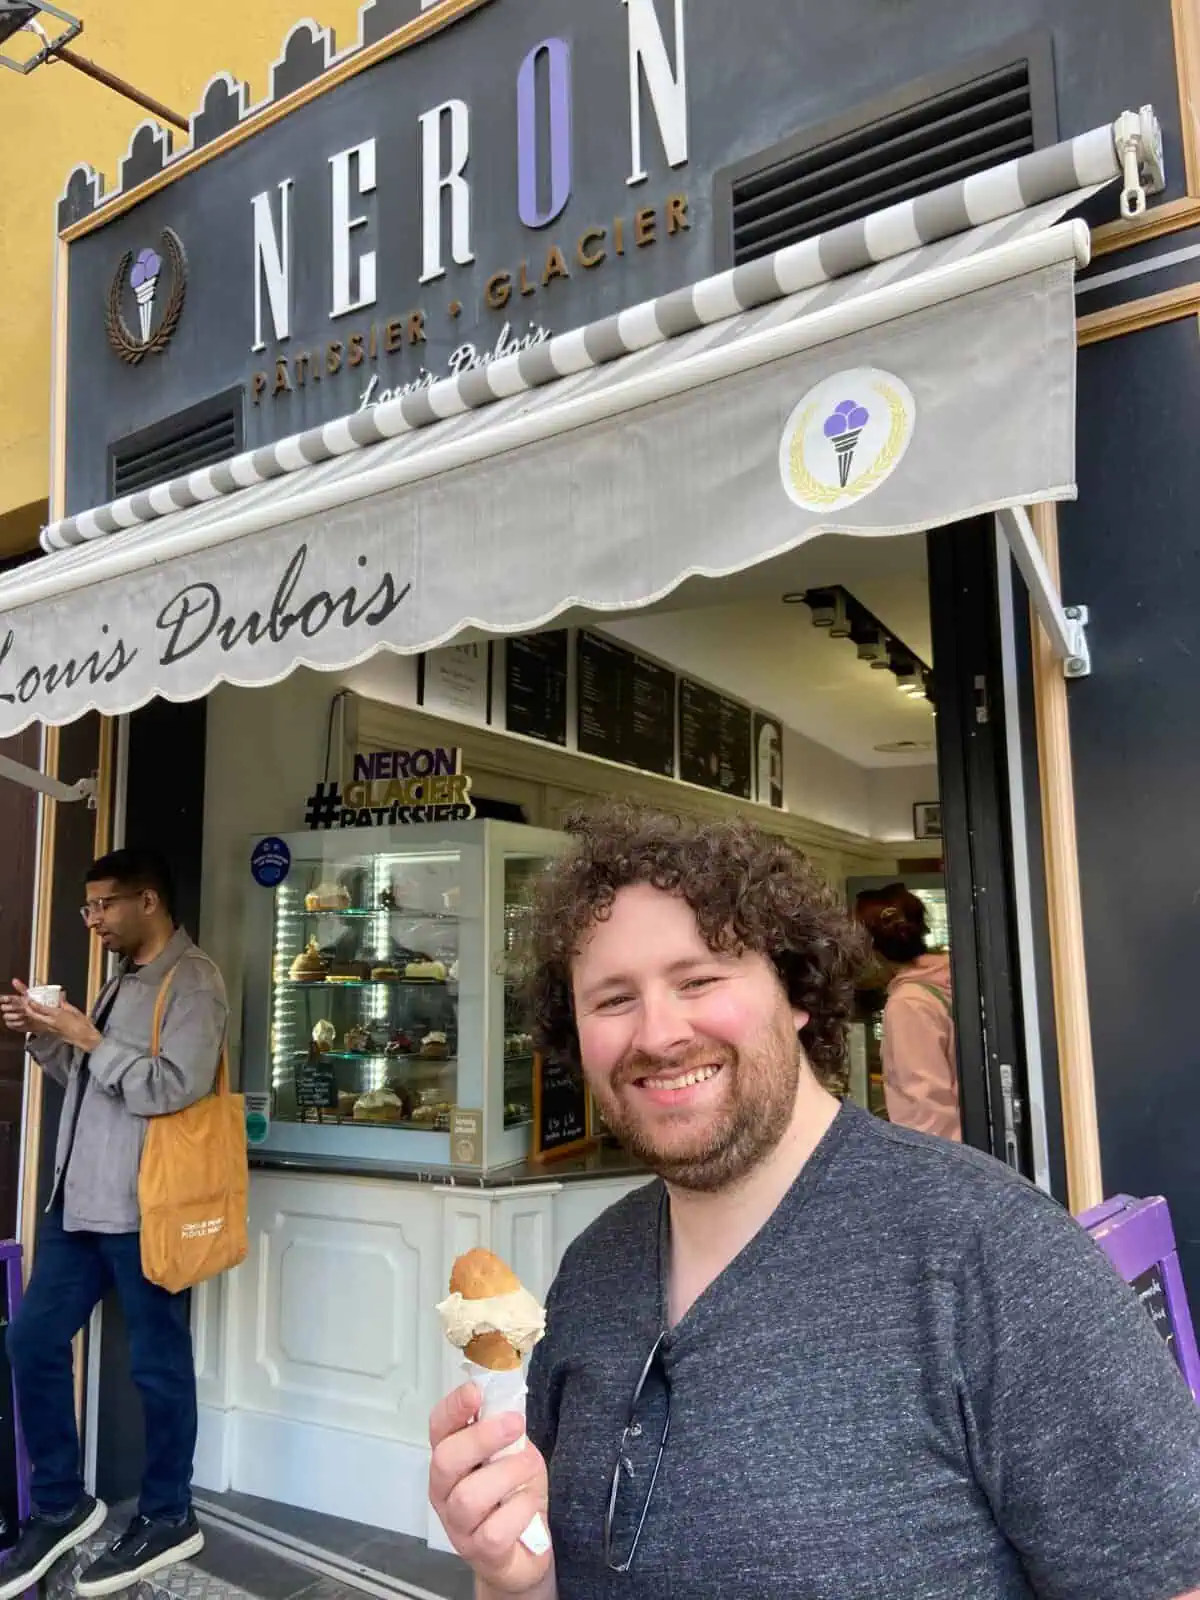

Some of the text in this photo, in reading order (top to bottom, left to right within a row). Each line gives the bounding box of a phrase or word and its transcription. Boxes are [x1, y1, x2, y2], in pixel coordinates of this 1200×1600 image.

[250, 0, 689, 353] NERON
[484, 194, 692, 310] GLACIER
[156, 543, 411, 666] Dubois
[342, 775, 472, 809] GLACIER
[353, 747, 462, 782] NERON
